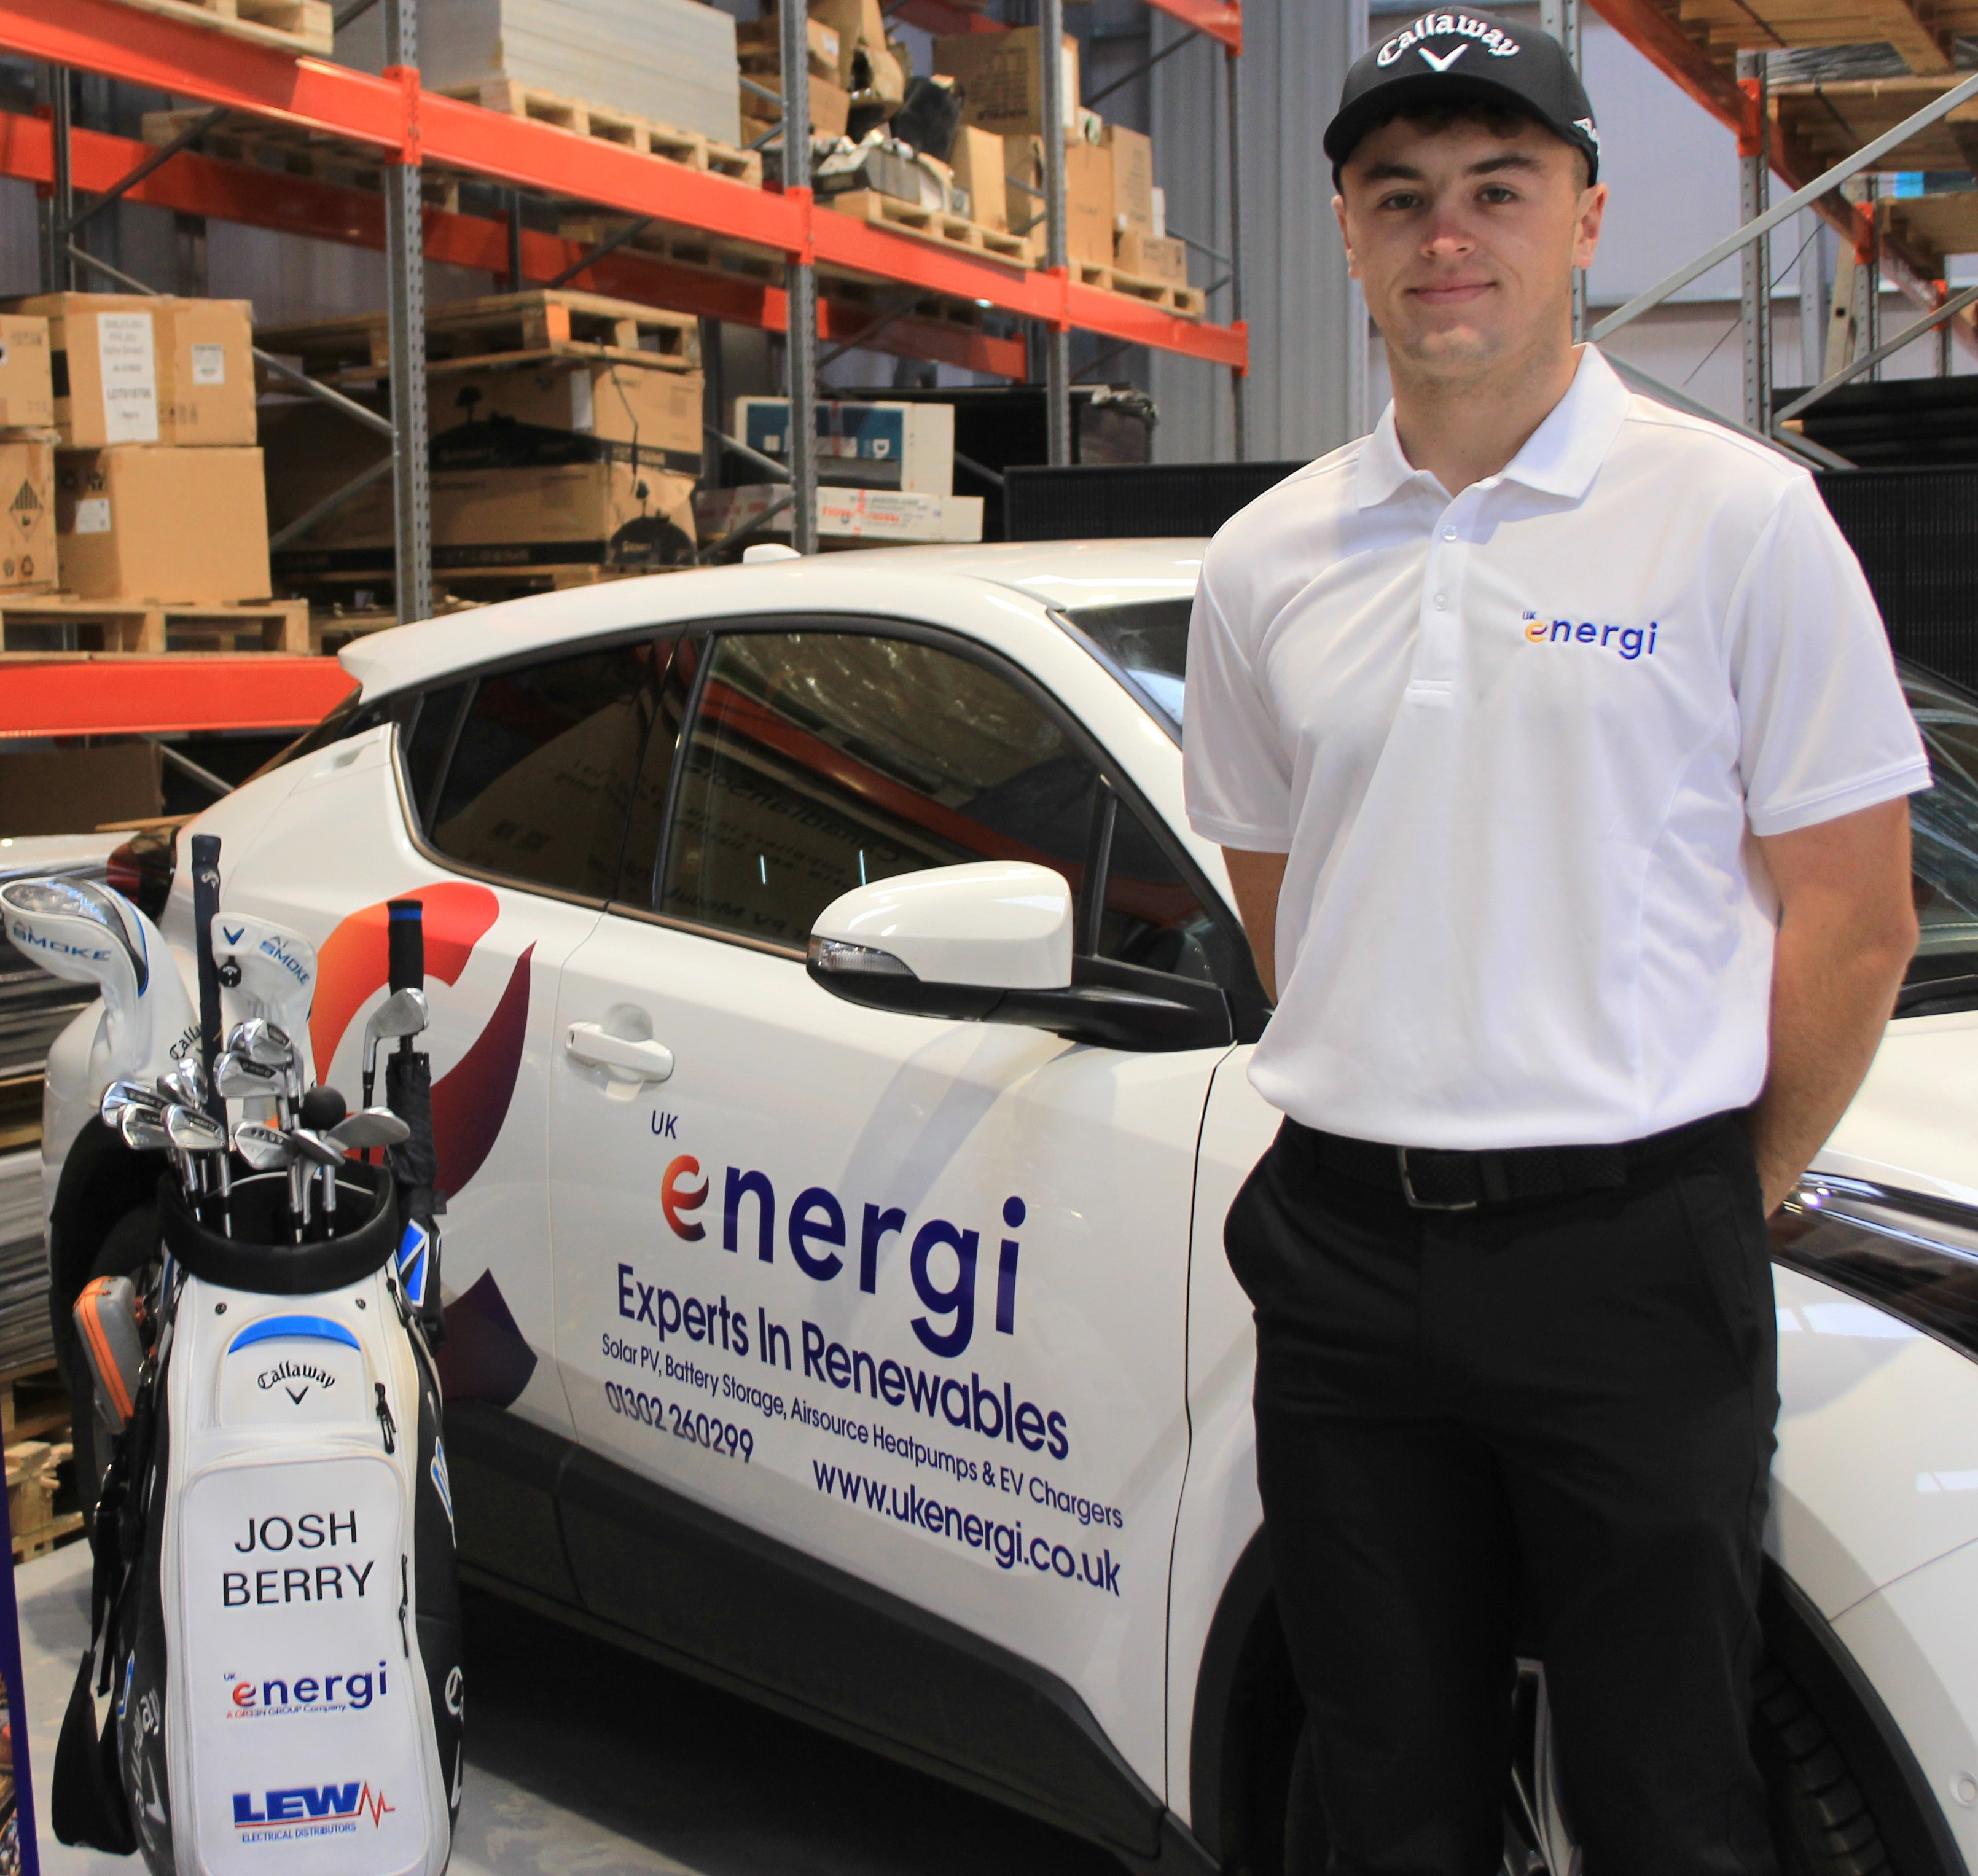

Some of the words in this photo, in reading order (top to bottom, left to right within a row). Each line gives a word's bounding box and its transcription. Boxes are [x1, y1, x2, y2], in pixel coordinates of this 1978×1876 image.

[1376, 14, 1520, 68] Callaway
[1522, 611, 1536, 620] UK
[1525, 620, 1657, 660] energi
[12, 924, 112, 961] SMOKE
[259, 940, 310, 985] SMOKE
[170, 1024, 201, 1060] Calla
[651, 1109, 678, 1139] UK
[661, 1155, 1026, 1359] energi
[257, 1360, 336, 1390] Callaway
[618, 1262, 749, 1357] Experts
[758, 1306, 792, 1372] In
[802, 1319, 1069, 1461] Renewables
[603, 1333, 638, 1366] Solar
[641, 1345, 662, 1378] PV,
[666, 1354, 719, 1398] Battery
[722, 1373, 787, 1420] Storage,
[791, 1397, 869, 1444] Airsource
[873, 1423, 977, 1482] Heatpumps
[982, 1460, 996, 1488] &
[1000, 1466, 1024, 1496] EV
[1028, 1477, 1123, 1529] Chargers
[605, 1381, 667, 1432] 01302
[669, 1402, 754, 1463] 260299
[235, 1509, 357, 1554] JOSH
[813, 1459, 1120, 1597] www.ukenergi.co.uk
[223, 1560, 374, 1608] BERRY
[224, 1673, 237, 1681] UK
[232, 1660, 386, 1709] energi
[268, 1705, 302, 1716] GROUP
[232, 1781, 361, 1823] LEW
[241, 1828, 293, 1843] ELECTRICAL
[295, 1821, 357, 1839] DISTRIBUTORS
